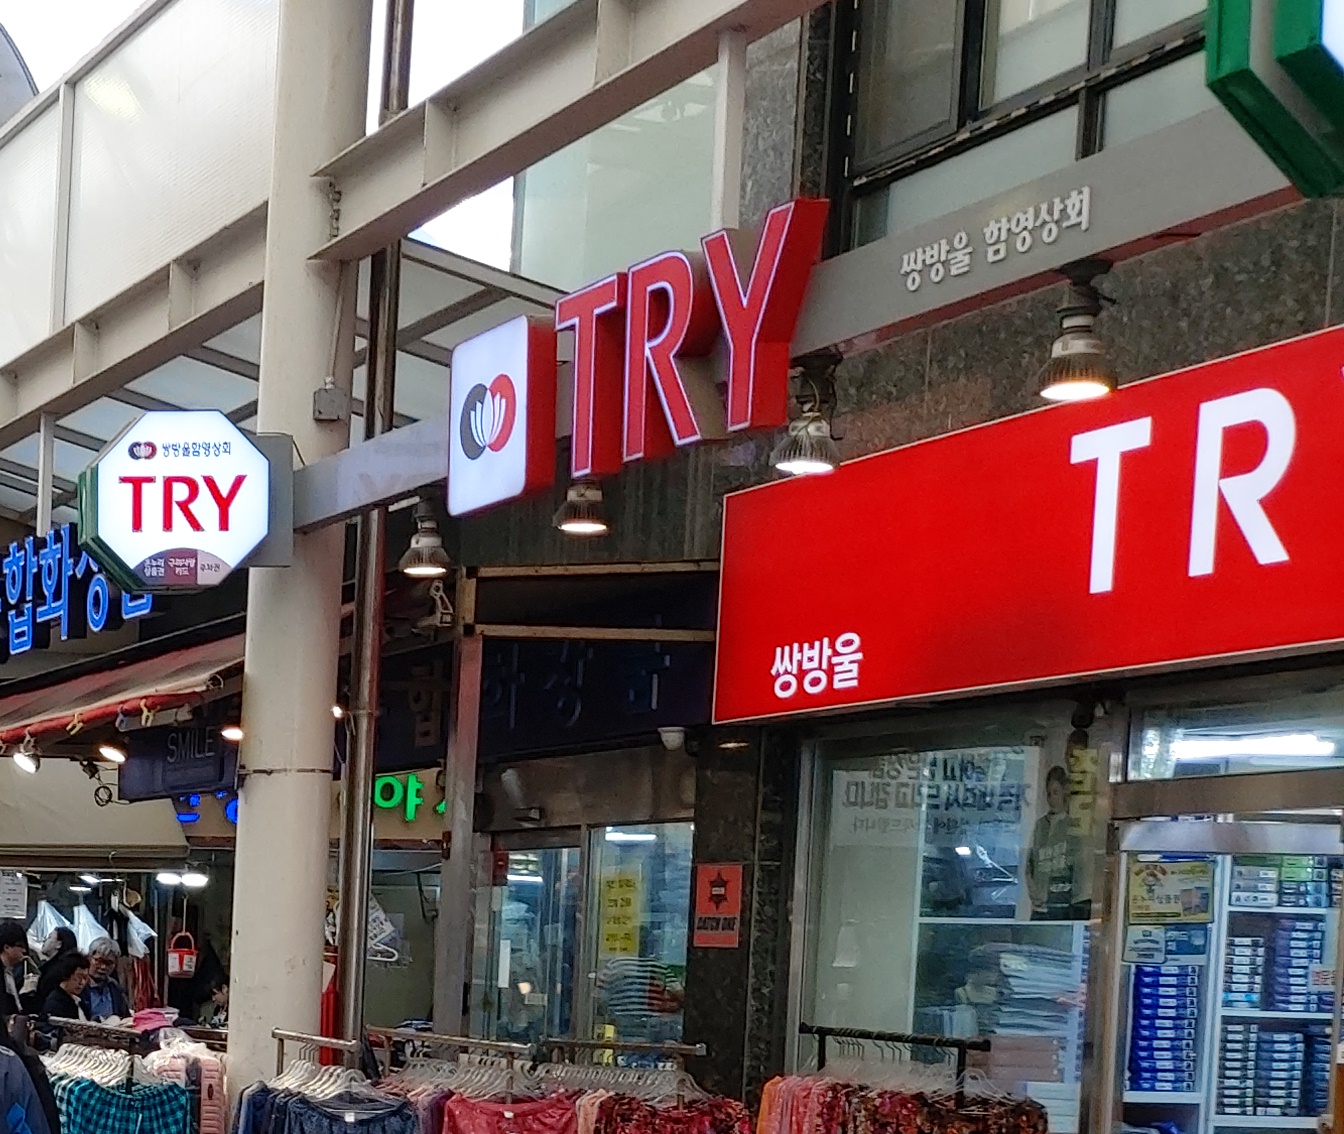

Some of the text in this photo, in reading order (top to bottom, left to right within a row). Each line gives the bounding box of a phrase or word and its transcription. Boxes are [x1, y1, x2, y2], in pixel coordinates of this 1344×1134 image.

[900, 185, 1092, 293] 쌍방울 함영상회
[556, 198, 830, 478] TRY
[118, 474, 249, 533] TRY
[1068, 386, 1301, 595] TR
[771, 631, 864, 700] 쌍방울
